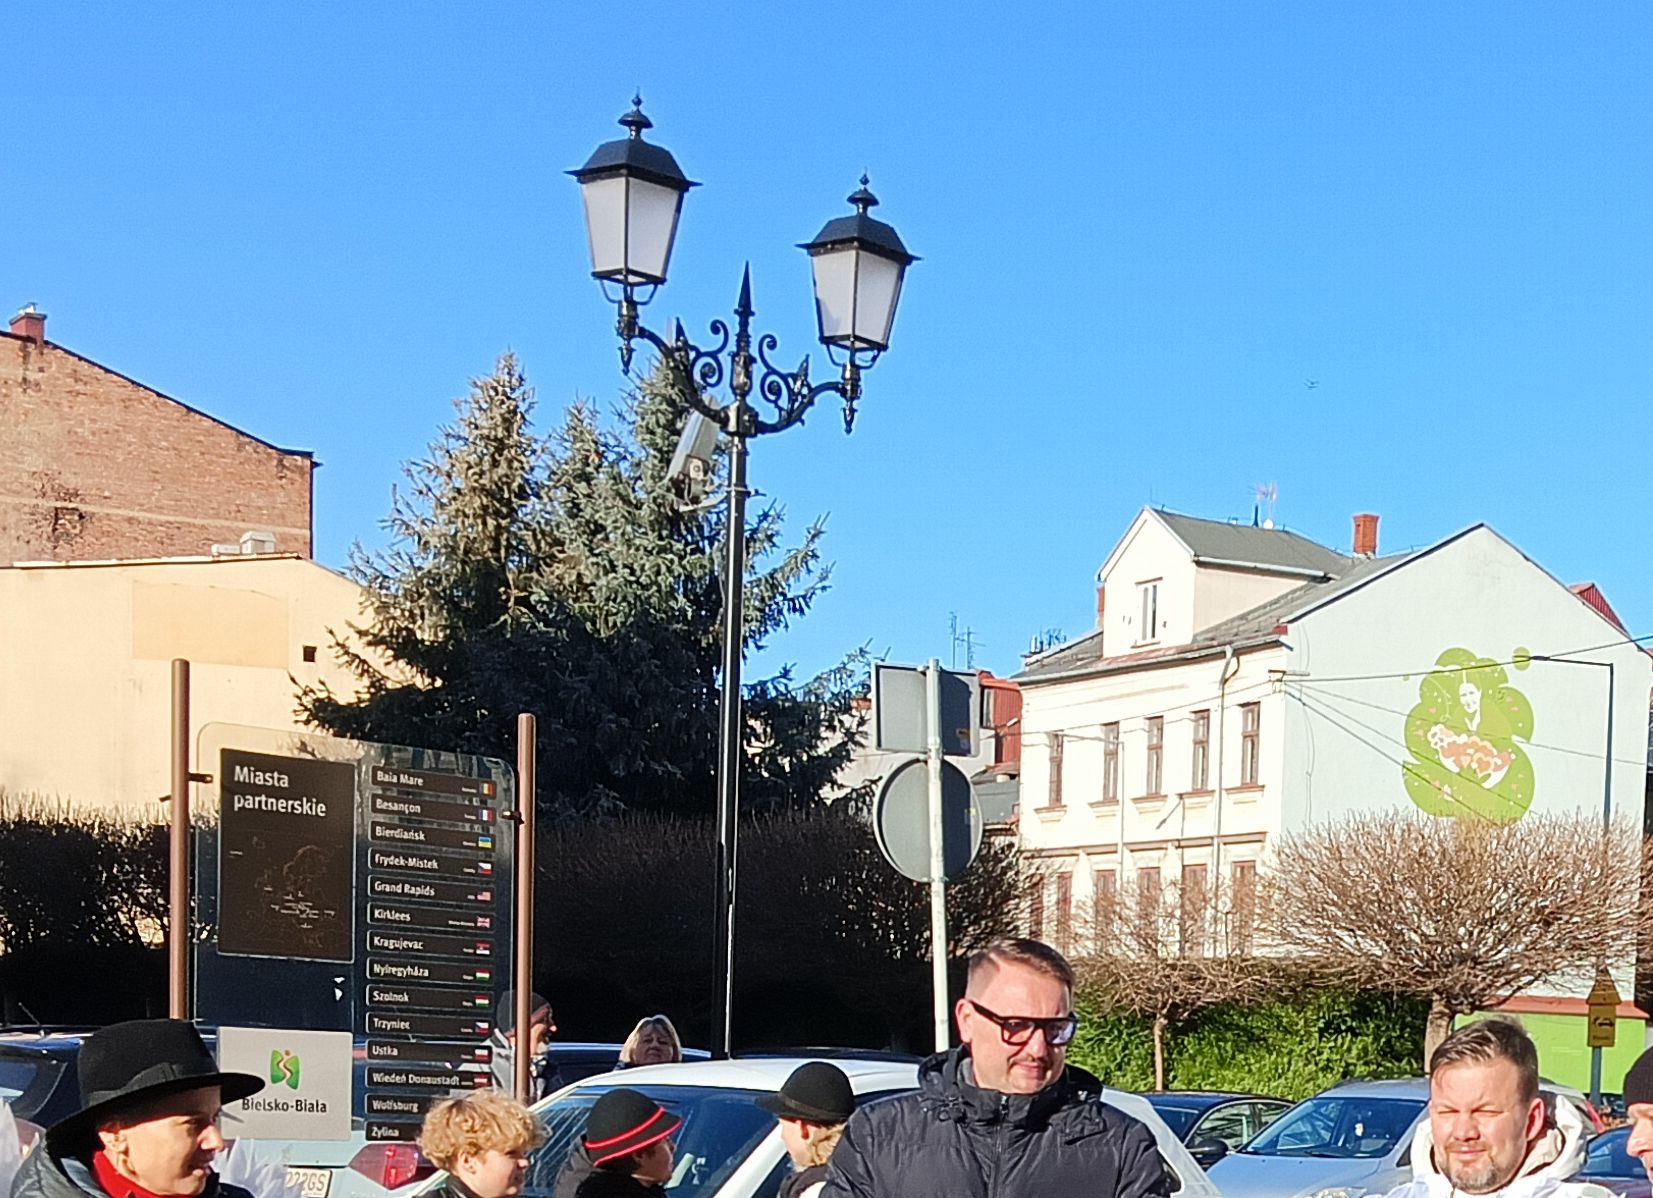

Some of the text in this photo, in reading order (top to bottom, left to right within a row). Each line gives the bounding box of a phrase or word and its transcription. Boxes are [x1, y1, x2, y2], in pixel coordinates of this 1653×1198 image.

[233, 765, 289, 788] Miasta
[376, 771, 424, 786] Baia Mare
[233, 794, 327, 817] partnerskie
[375, 798, 421, 814] Besançon
[374, 881, 436, 897] Grand Rapids
[374, 908, 411, 922] Kirklees
[373, 936, 424, 950] Kragujevac
[373, 1018, 411, 1031] Trzyniec
[372, 1045, 399, 1056] Ustka
[372, 1072, 460, 1086] Wiedeń Donaustadt
